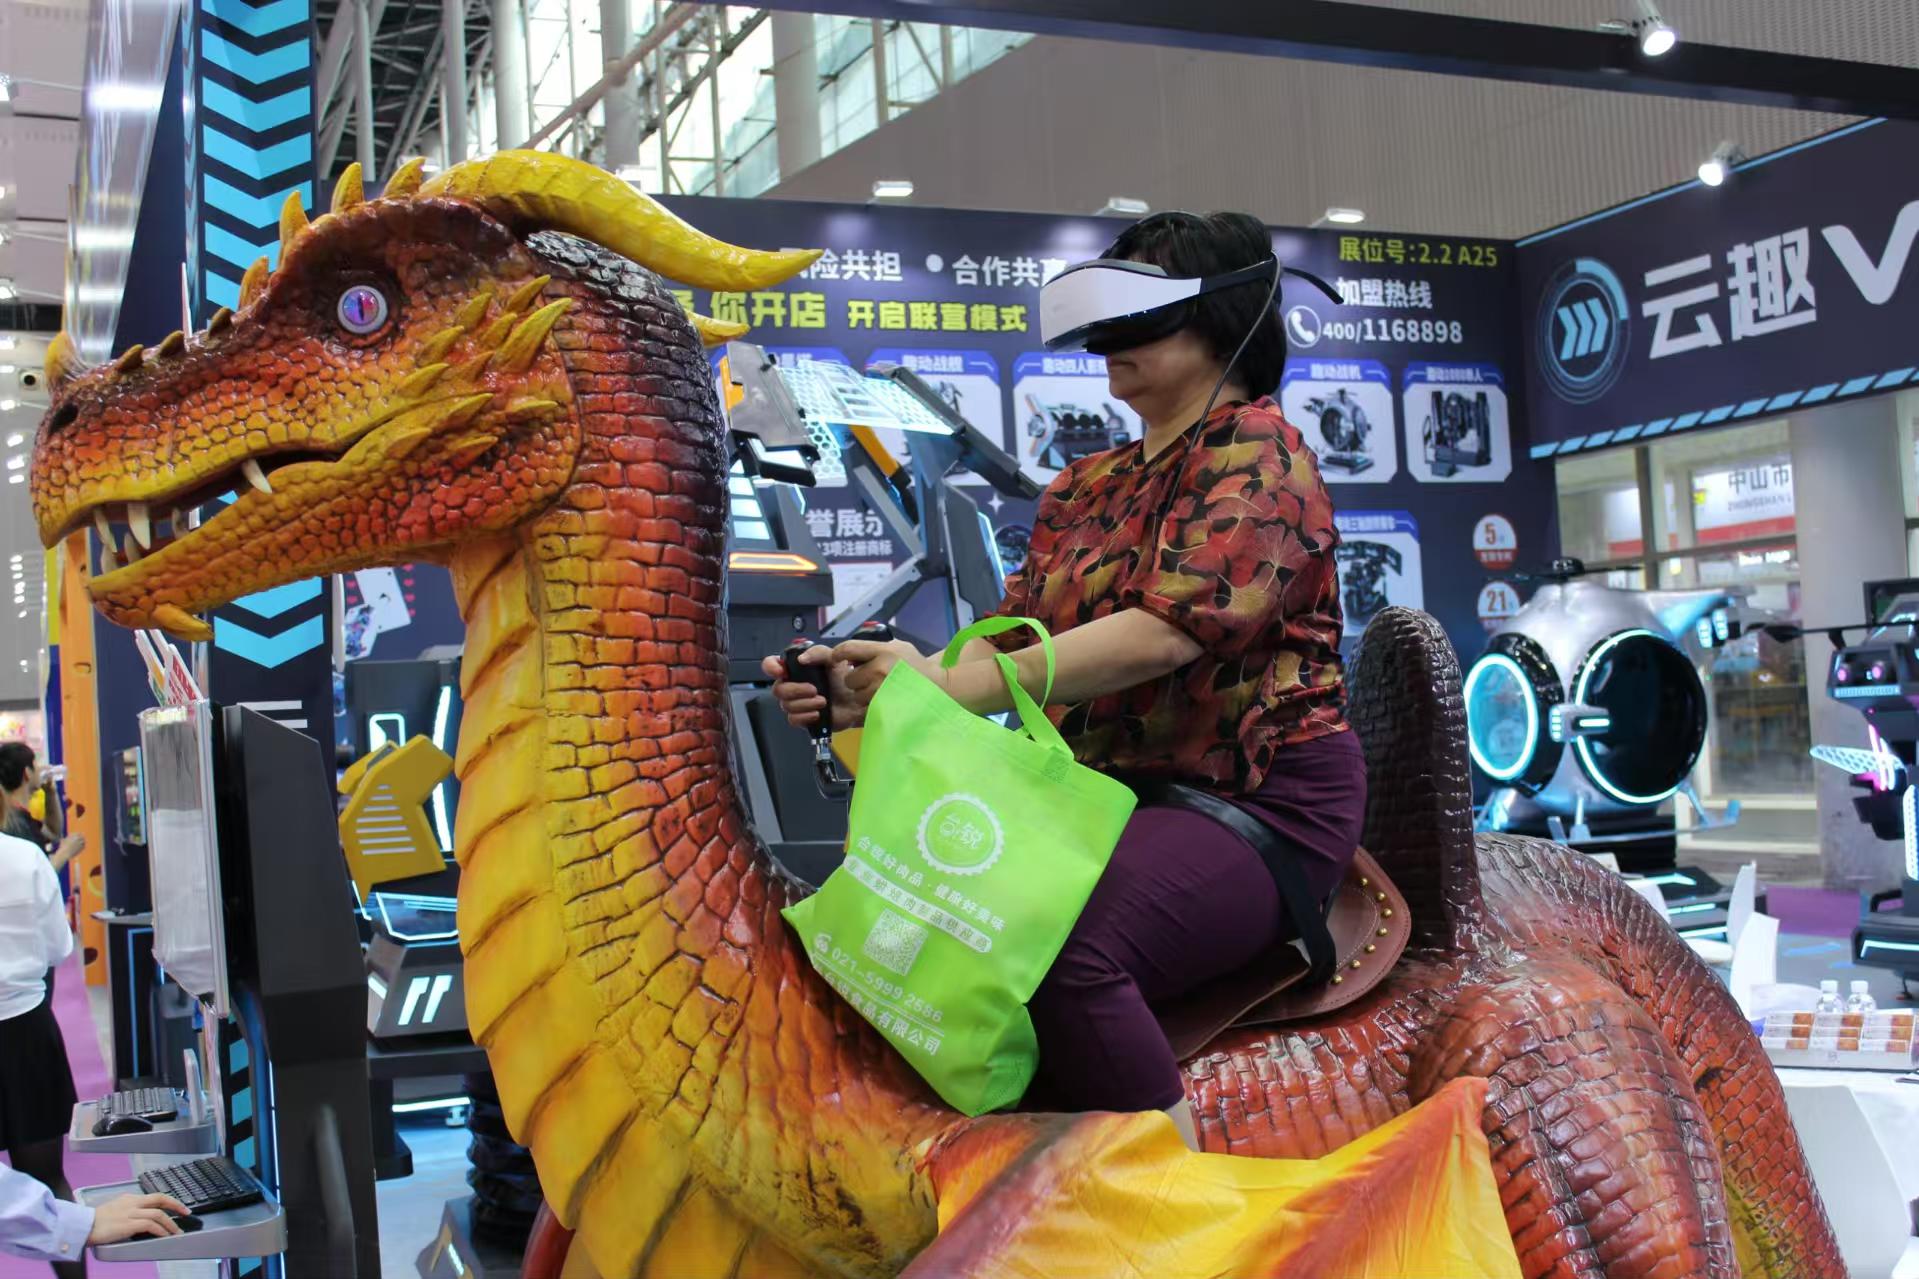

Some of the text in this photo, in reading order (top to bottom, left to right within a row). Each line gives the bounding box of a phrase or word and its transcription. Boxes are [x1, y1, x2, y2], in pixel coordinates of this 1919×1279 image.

[780, 247, 903, 282] 险共担
[1458, 246, 1498, 267] A25
[1336, 277, 1433, 309] 加盟热线
[847, 299, 1029, 333] 开启联营模式
[1322, 317, 1463, 343] 400/1168898
[1728, 464, 1790, 495] 中山市
[816, 540, 893, 556] 3项注册商标
[1486, 590, 1508, 612] 21
